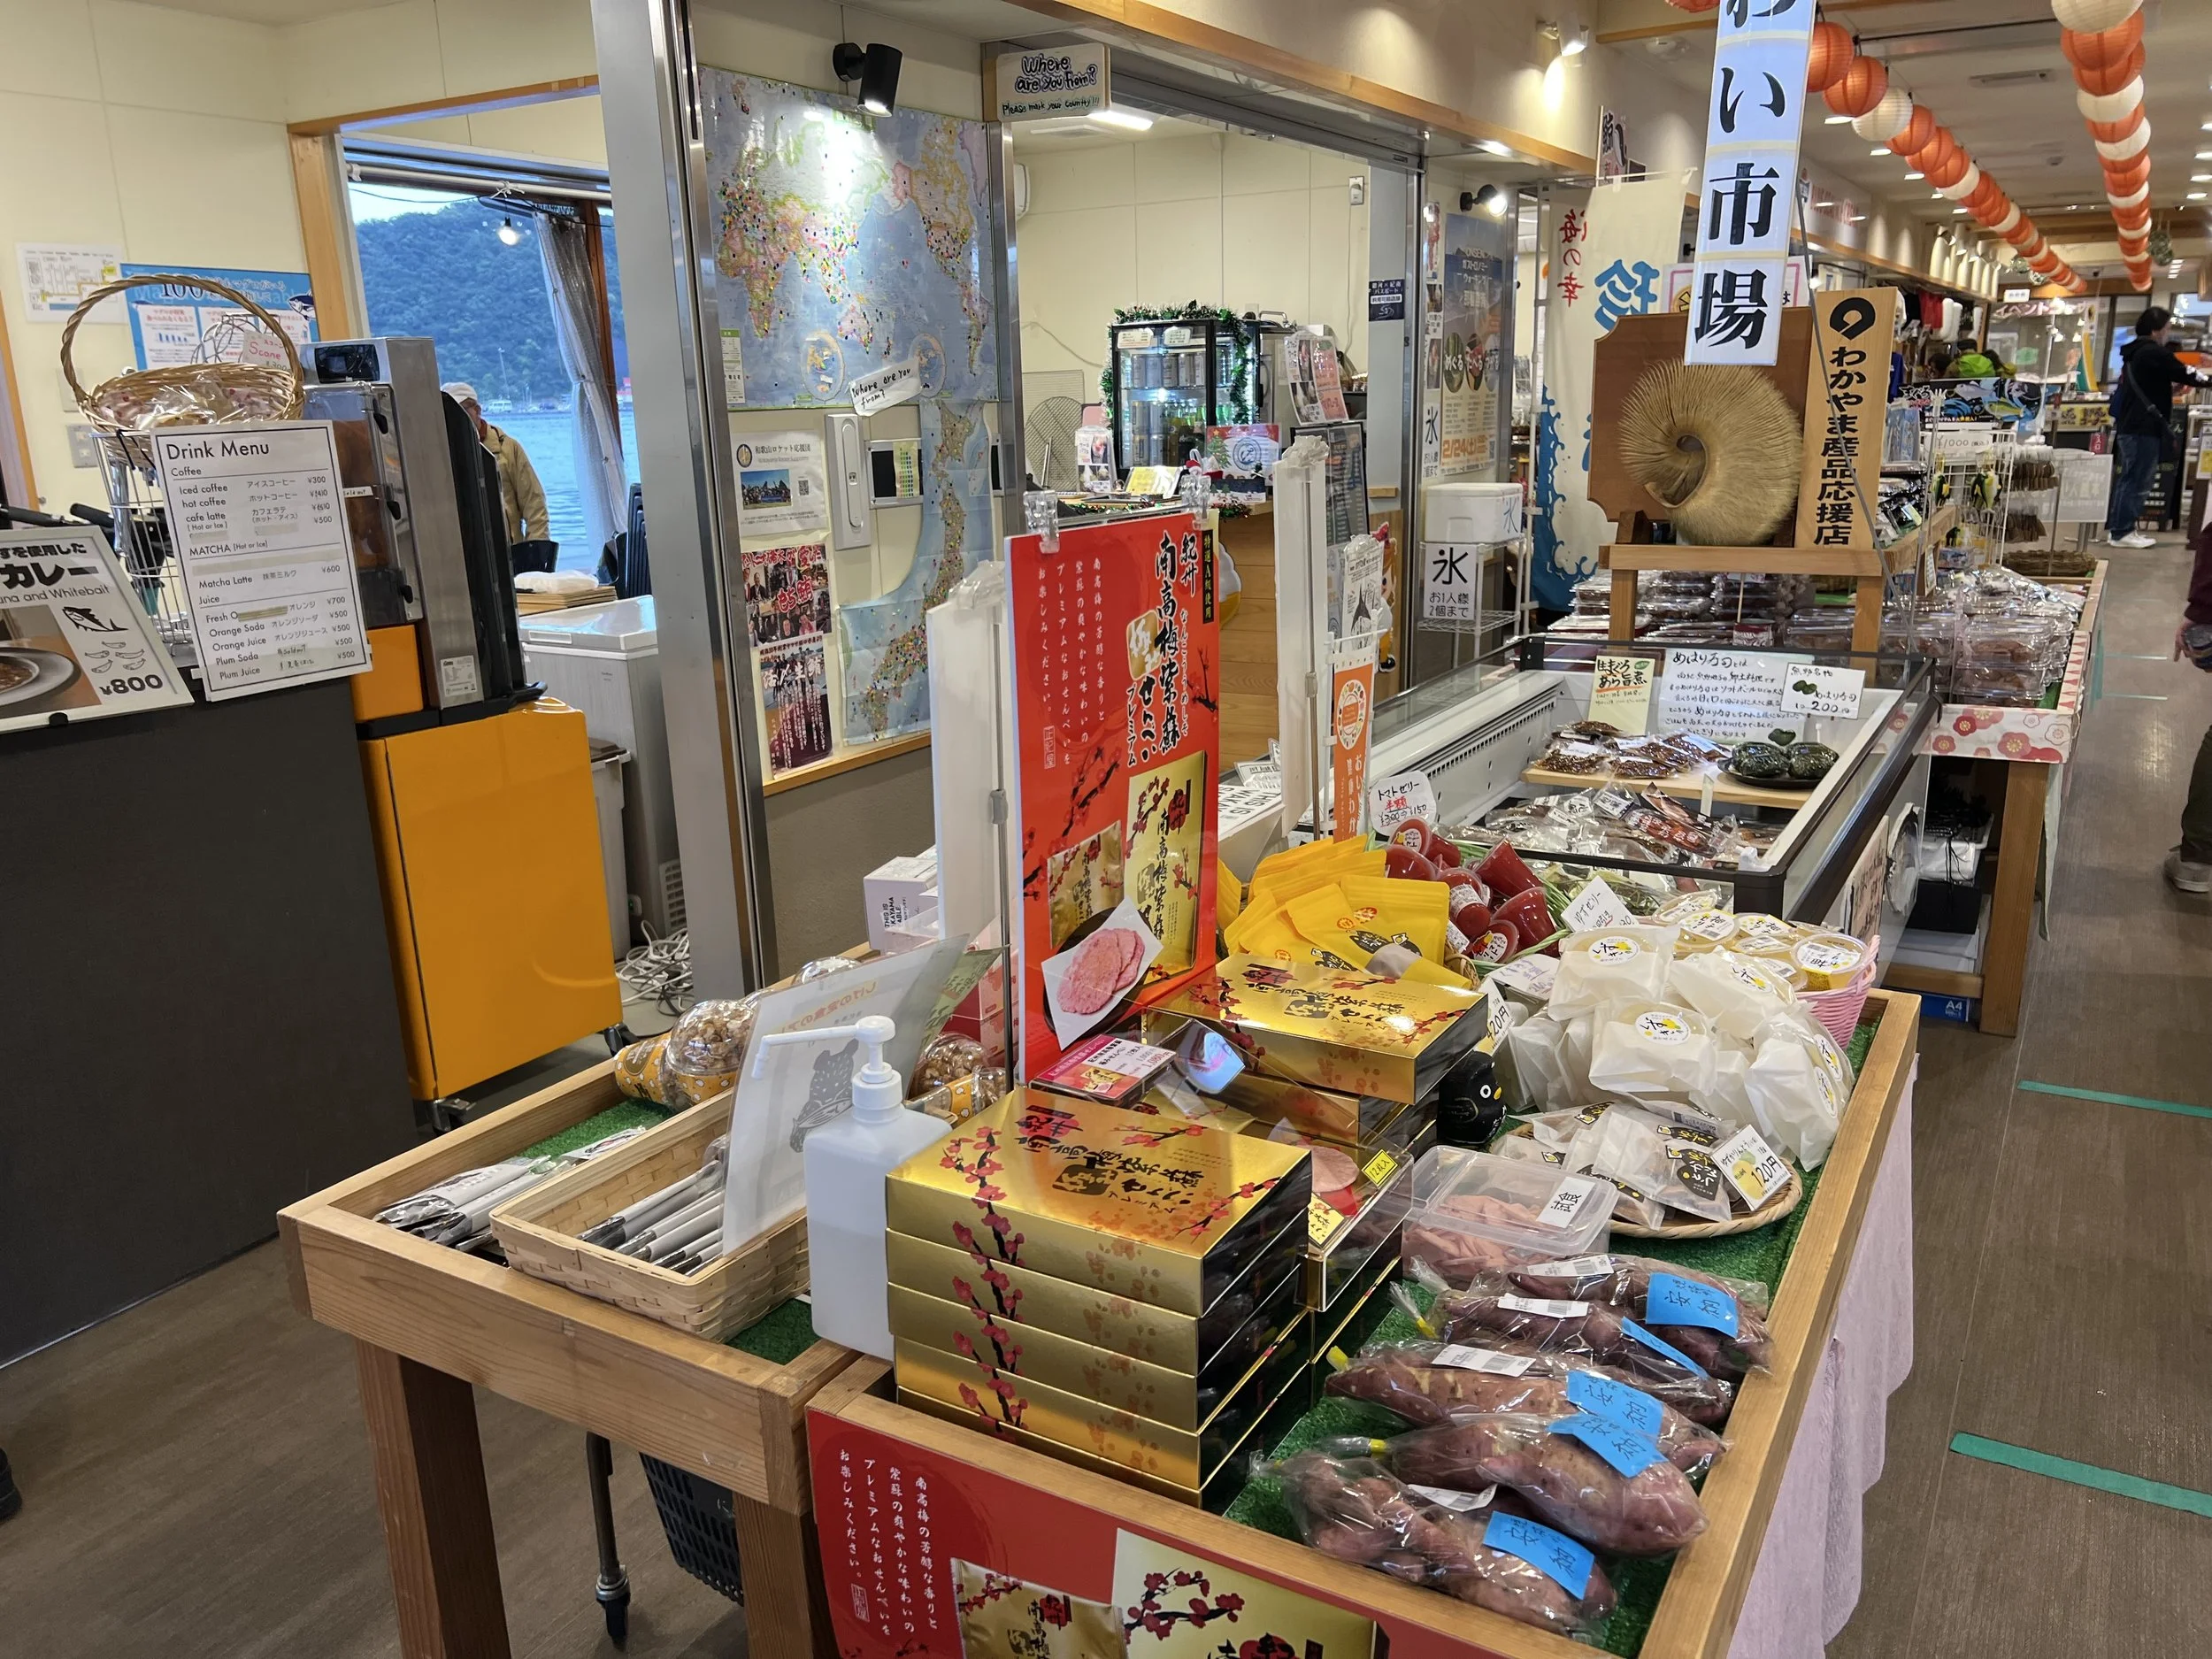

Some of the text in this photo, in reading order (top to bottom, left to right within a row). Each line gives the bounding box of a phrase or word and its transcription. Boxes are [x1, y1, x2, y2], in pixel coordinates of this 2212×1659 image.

[1022, 53, 1070, 76] Where
[1016, 64, 1098, 93] are you from?
[1002, 100, 1026, 115] Please
[1029, 101, 1045, 111] mark
[1048, 101, 1062, 110] your
[249, 342, 281, 359] Scone
[851, 381, 878, 398] Where
[883, 373, 896, 384] are
[861, 389, 886, 409] from?
[1425, 406, 1439, 445] 氷
[166, 440, 270, 460] Drink Menu
[171, 466, 202, 477] Coffee
[180, 475, 326, 495] Iced coffee アイスコーヒー ¥300
[182, 493, 298, 508] hot coffee ホットコーヒー
[186, 506, 287, 522] cafe latte カフェラテ
[313, 515, 333, 525] ¥500
[189, 544, 231, 557] MATCHA
[0, 562, 99, 589] カレー
[199, 578, 231, 589] Matcha
[234, 576, 253, 585] Latte
[321, 565, 341, 573] ¥600
[1432, 547, 1469, 585] 氷
[26, 585, 110, 602] and Whitebait
[199, 595, 220, 605] Juice
[1429, 591, 1469, 604] お1人様
[206, 614, 228, 624] Fresh
[326, 596, 346, 605] ¥700
[1429, 605, 1469, 618] 2個まで
[209, 627, 242, 639] Orange
[244, 623, 265, 633] Soda
[329, 610, 349, 618] ¥500
[212, 641, 245, 653] Orange
[247, 637, 267, 647] Juice
[332, 624, 350, 633] ¥500
[216, 637, 353, 666] Plum Soda ¥500
[219, 651, 356, 680] Plum Juice ¥500
[99, 674, 163, 695] ¥800
[1378, 781, 1420, 801] トマトゼリー
[1946, 1001, 1962, 1010] A4
[1751, 1156, 1783, 1188] 120円
[840, 1448, 863, 1578] お楽しみください。
[864, 1458, 891, 1636] プレミアムなおせんべいを
[889, 1466, 915, 1633] 紫蘇の爽やかな味わいの
[915, 1476, 938, 1630] 南高梅の芳醇な香りと
